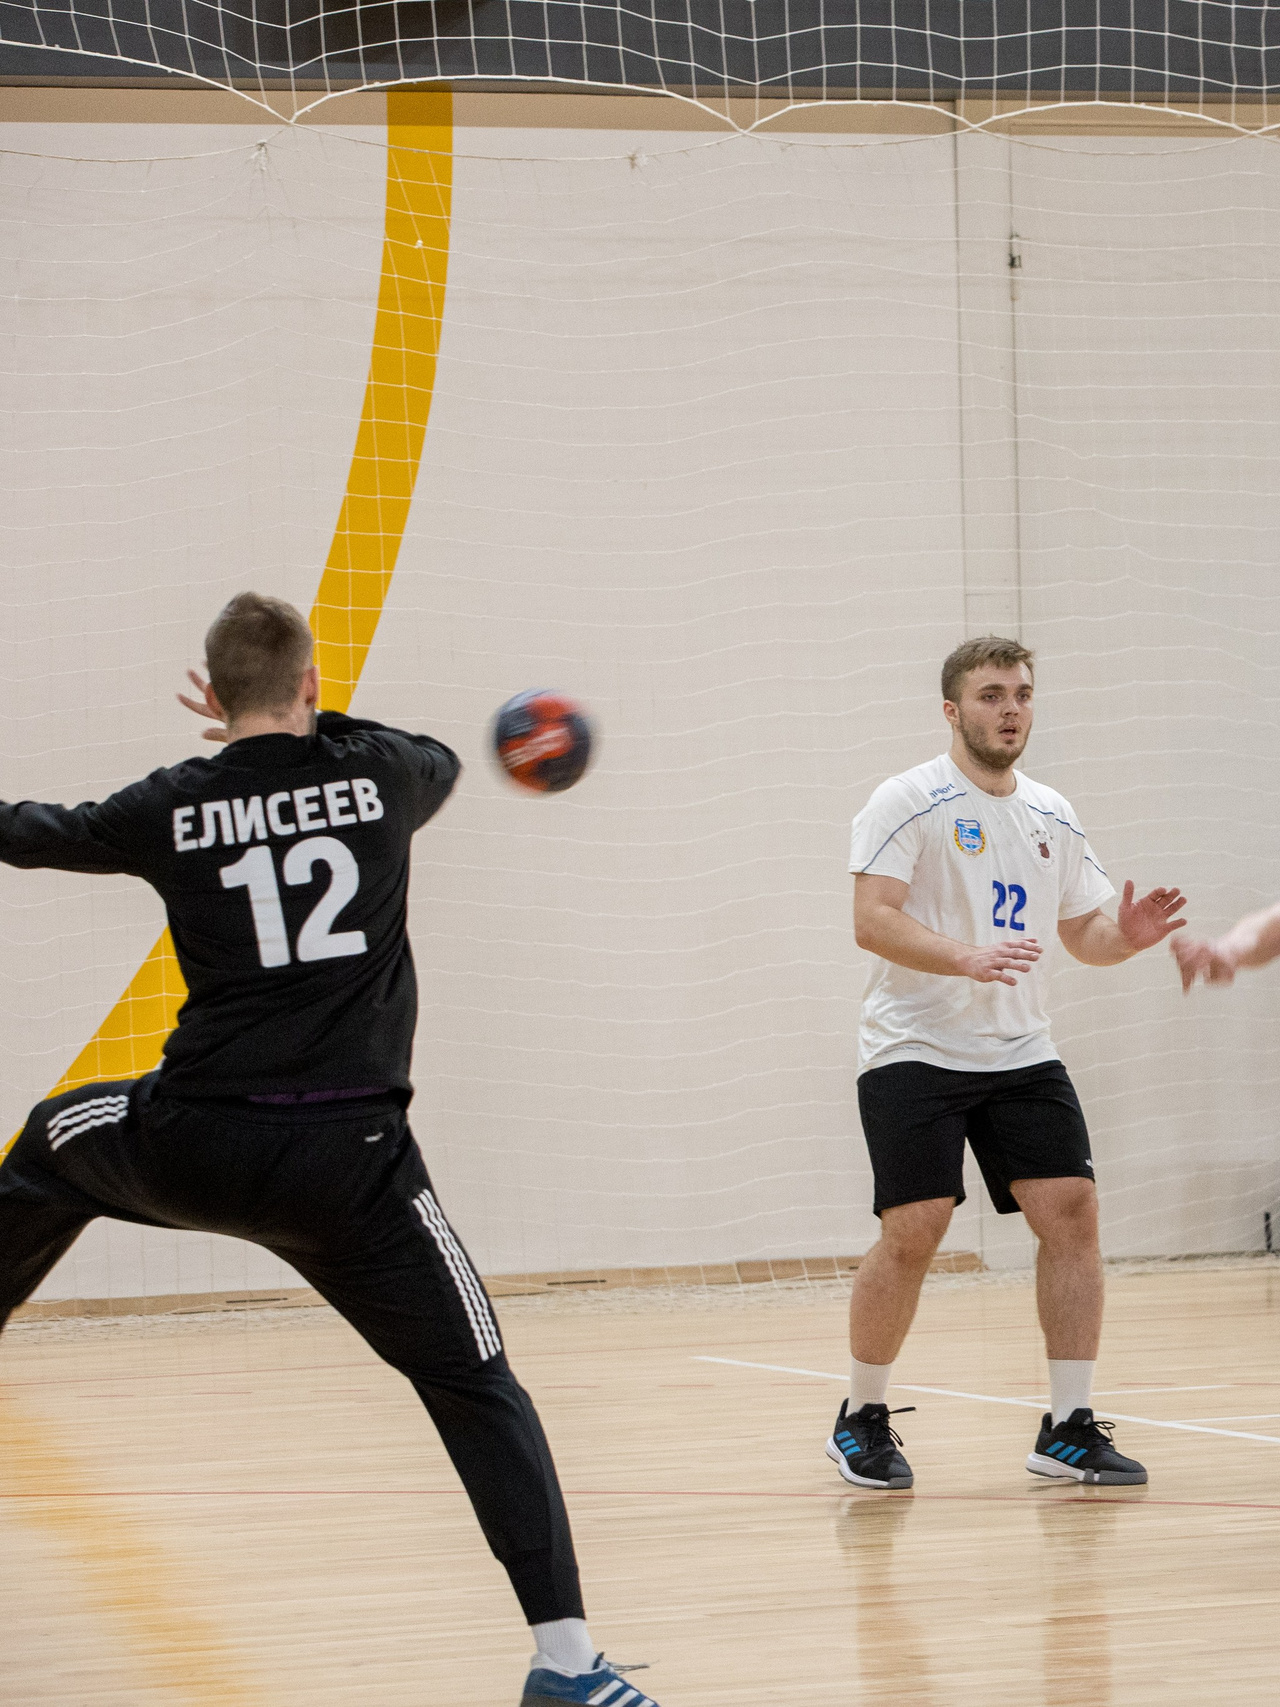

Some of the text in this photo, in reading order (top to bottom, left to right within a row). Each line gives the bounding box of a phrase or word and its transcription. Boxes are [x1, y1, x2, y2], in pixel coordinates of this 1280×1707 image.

[173, 778, 384, 852] ЕЛИСЕЕВ
[219, 836, 368, 968] 12
[992, 879, 1027, 931] 22
